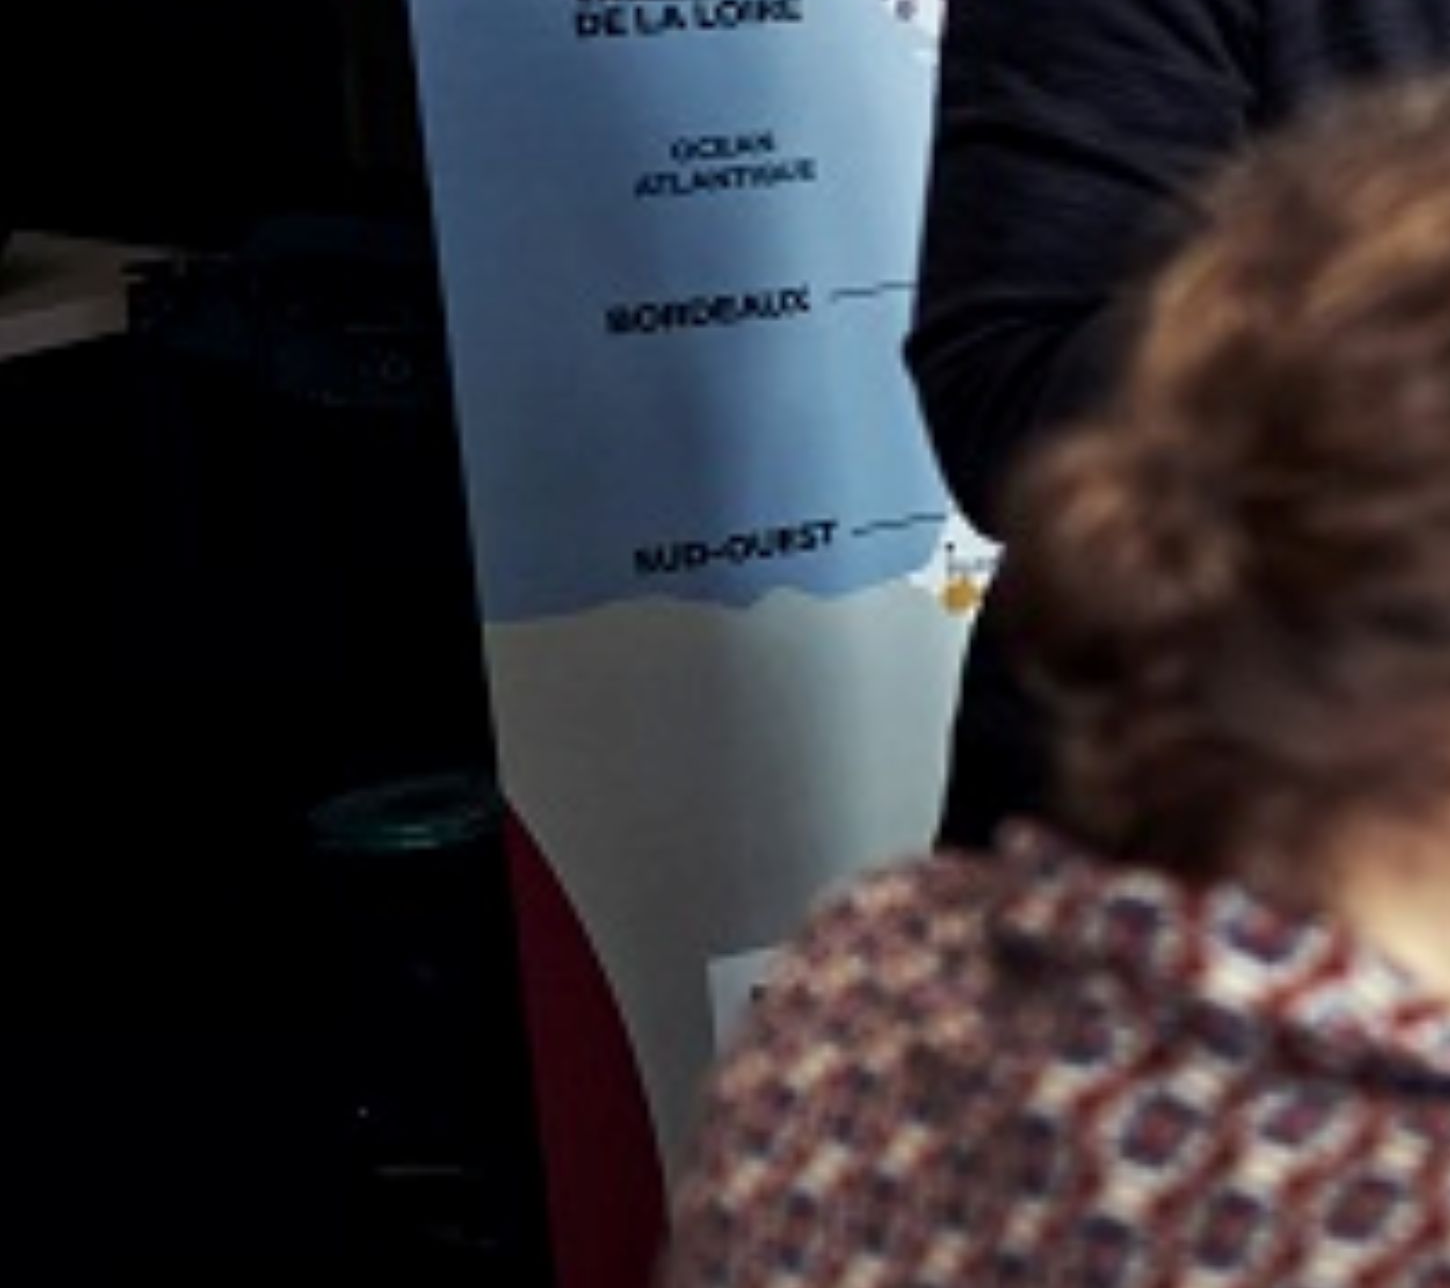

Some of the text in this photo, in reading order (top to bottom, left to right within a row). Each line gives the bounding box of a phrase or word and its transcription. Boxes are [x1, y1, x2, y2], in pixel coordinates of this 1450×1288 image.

[575, 7, 628, 39] DE
[635, 3, 687, 36] LA
[634, 158, 817, 200] ATLANTIQUE
[606, 283, 810, 336] BORDEAUX
[633, 520, 838, 577] SUD-OUEST
